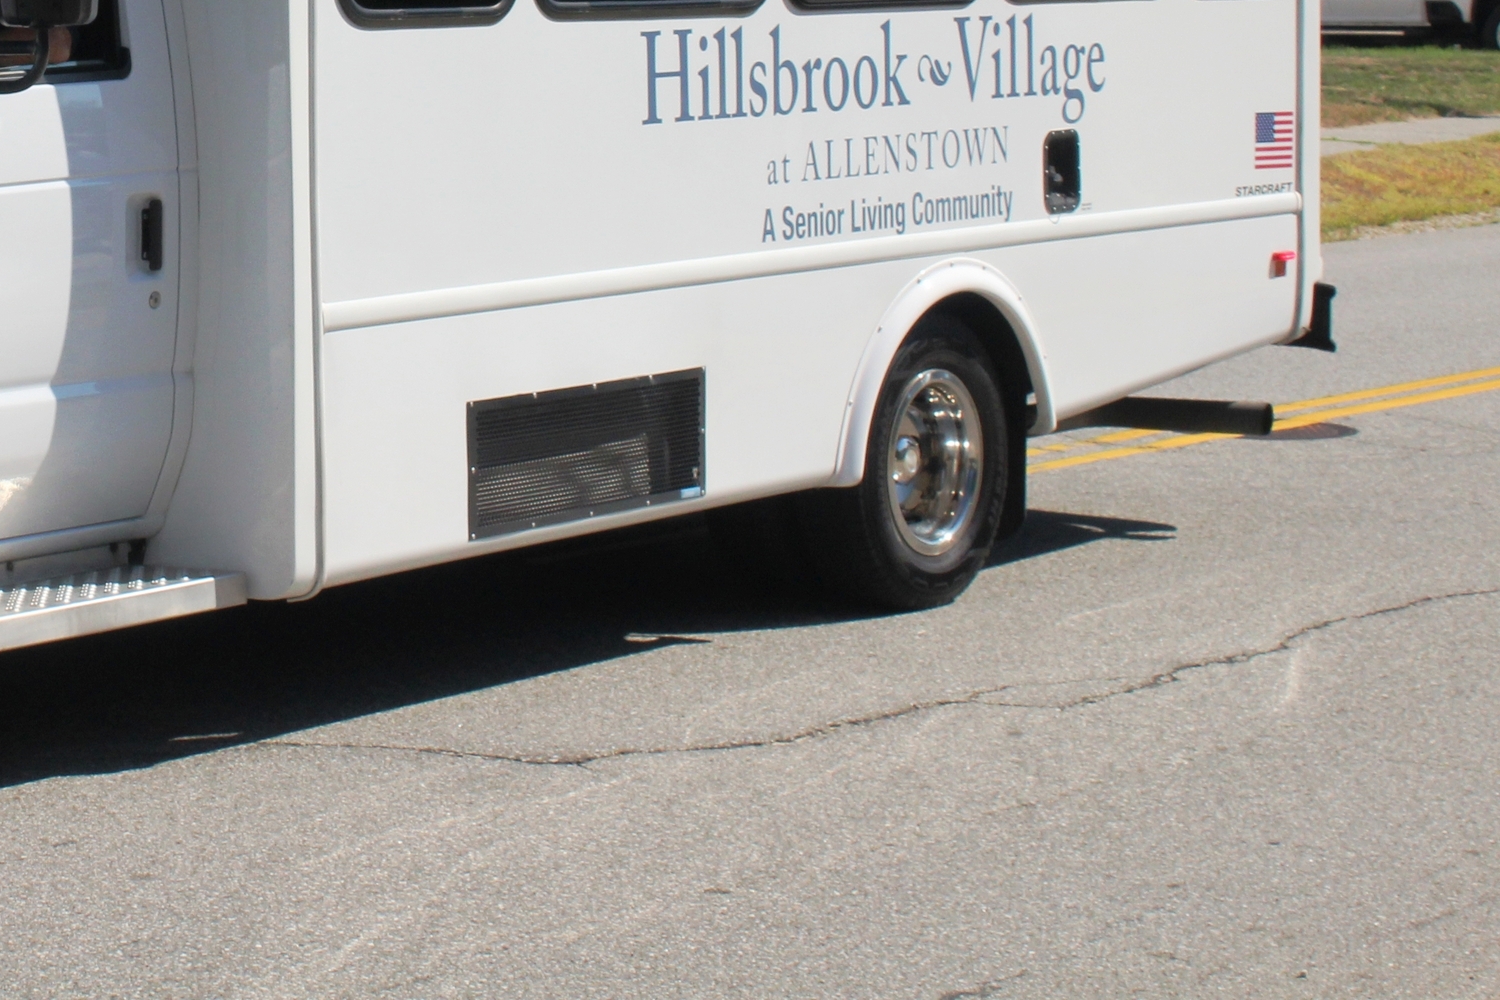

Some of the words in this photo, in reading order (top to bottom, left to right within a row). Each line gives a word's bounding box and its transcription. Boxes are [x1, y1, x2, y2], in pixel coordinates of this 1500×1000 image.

[640, 19, 911, 126] Hillsbrook
[953, 13, 1106, 124] Village
[766, 153, 791, 185] at
[801, 126, 1009, 182] ALLENSTOWN
[762, 210, 777, 243] A
[782, 203, 845, 240] Senior
[851, 196, 906, 234] Living
[912, 185, 1013, 224] Community
[1235, 182, 1293, 197] STARCRAFT
